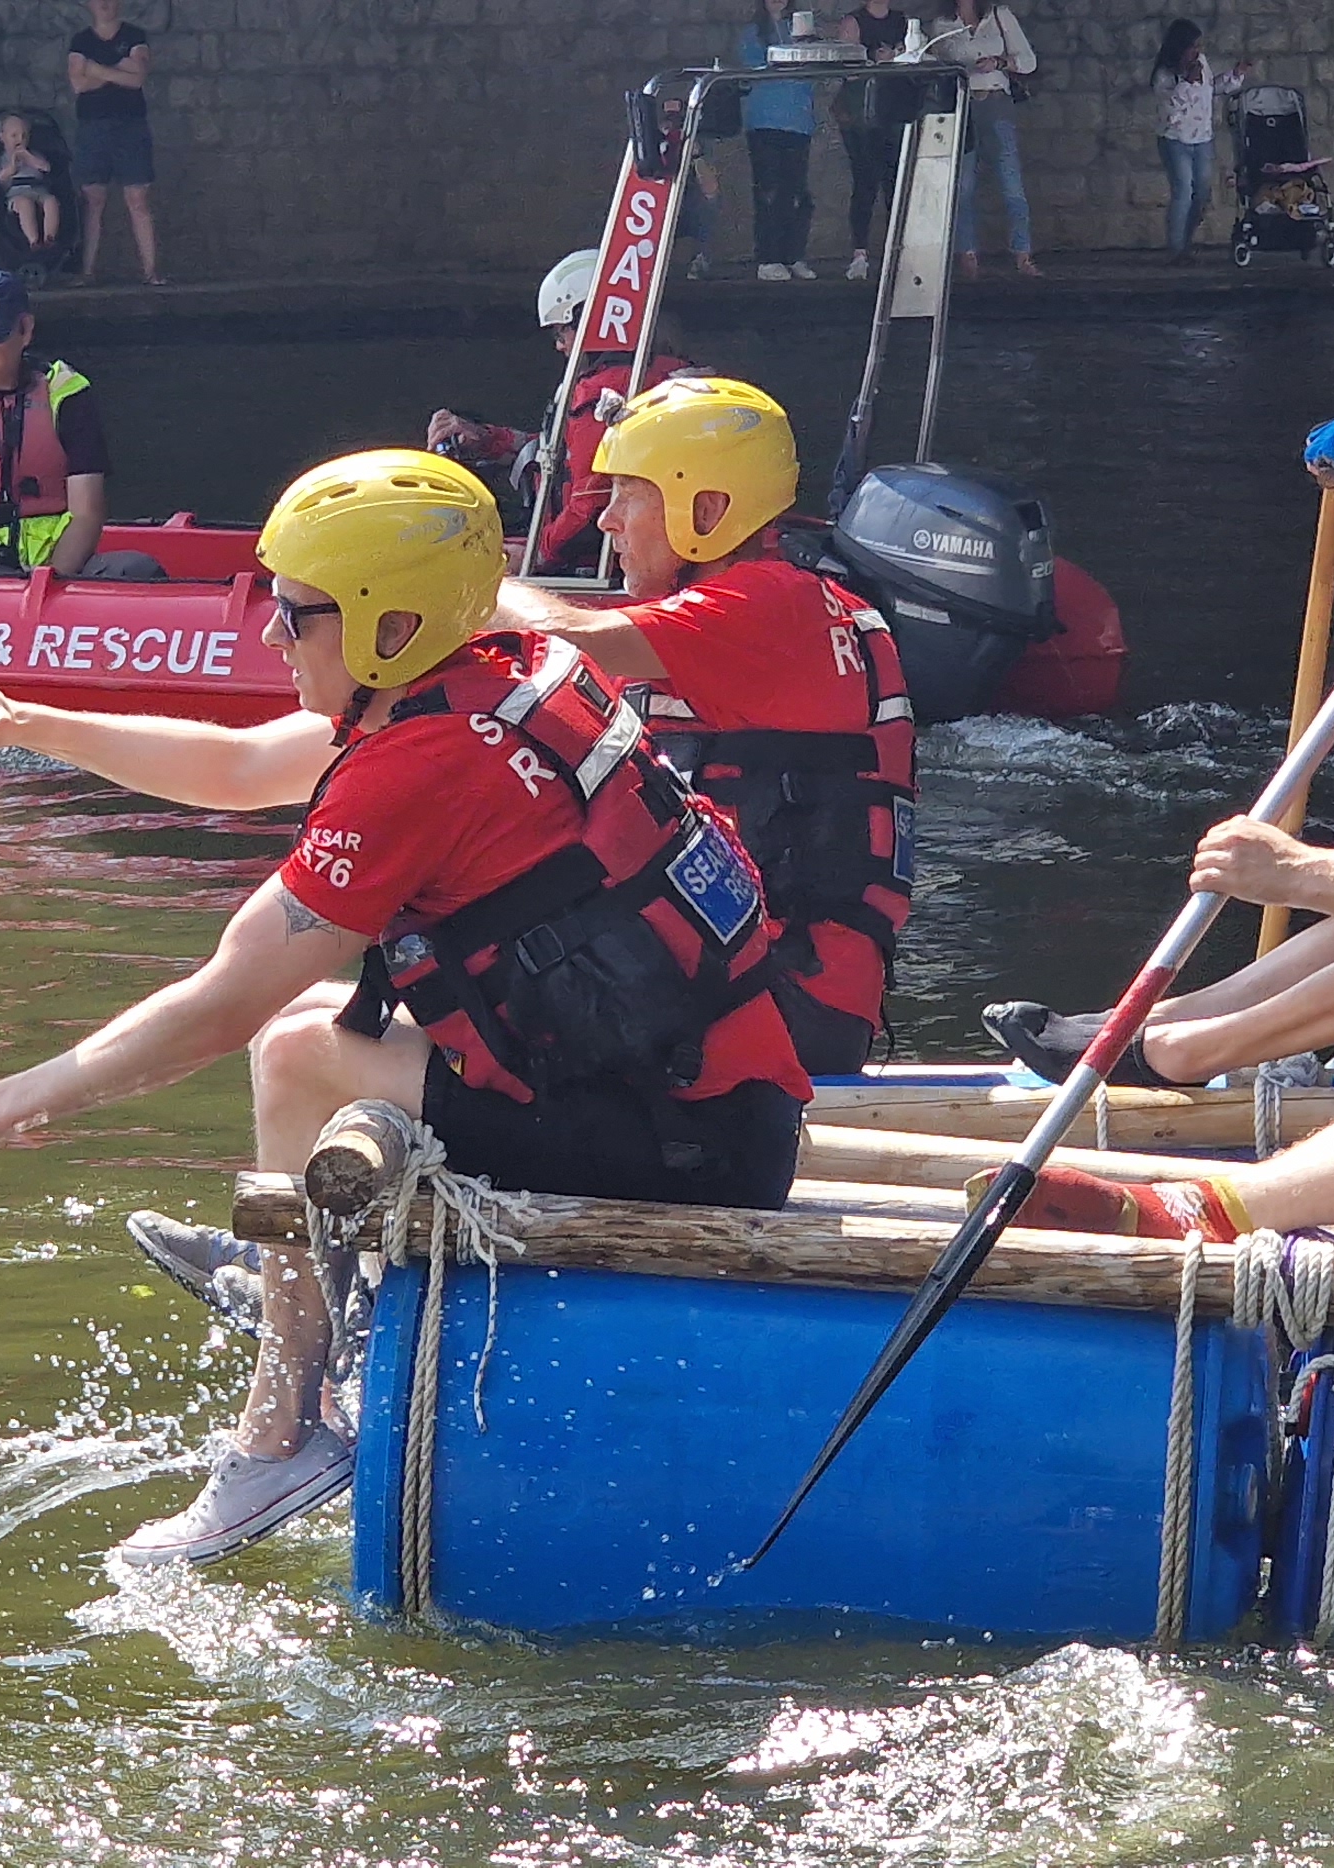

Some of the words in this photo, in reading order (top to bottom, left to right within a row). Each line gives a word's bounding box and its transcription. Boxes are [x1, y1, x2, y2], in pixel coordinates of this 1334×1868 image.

[598, 190, 656, 344] SAR
[931, 533, 995, 560] YAMAHA
[27, 624, 239, 676] RESCUE
[310, 827, 362, 852] KSAR
